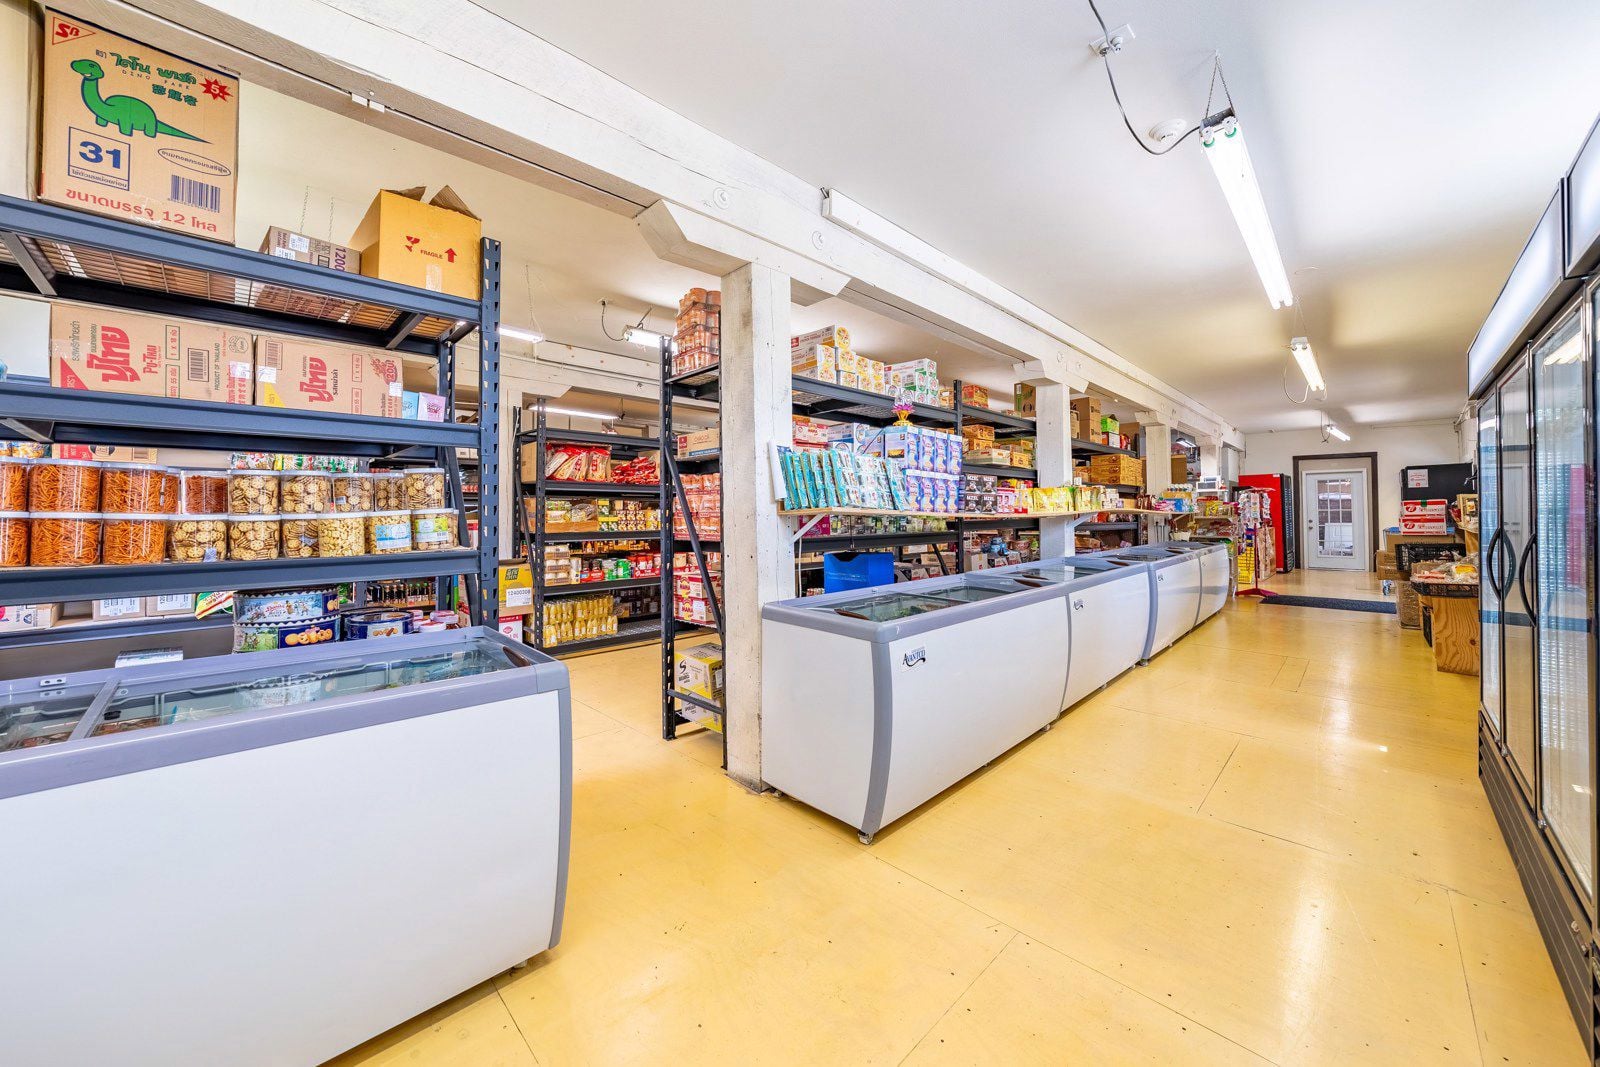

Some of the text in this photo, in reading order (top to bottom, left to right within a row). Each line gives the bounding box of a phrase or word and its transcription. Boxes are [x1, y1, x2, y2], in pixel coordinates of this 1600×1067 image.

[122, 69, 191, 90] DINO PARK
[79, 141, 121, 169] 31
[65, 188, 155, 221] ขนาดบรรจุ
[162, 210, 185, 226] 12
[191, 216, 218, 233] โหล
[420, 249, 443, 260] FRAGILE
[87, 325, 141, 382] ปูไทย
[300, 356, 335, 403] ปูไทย
